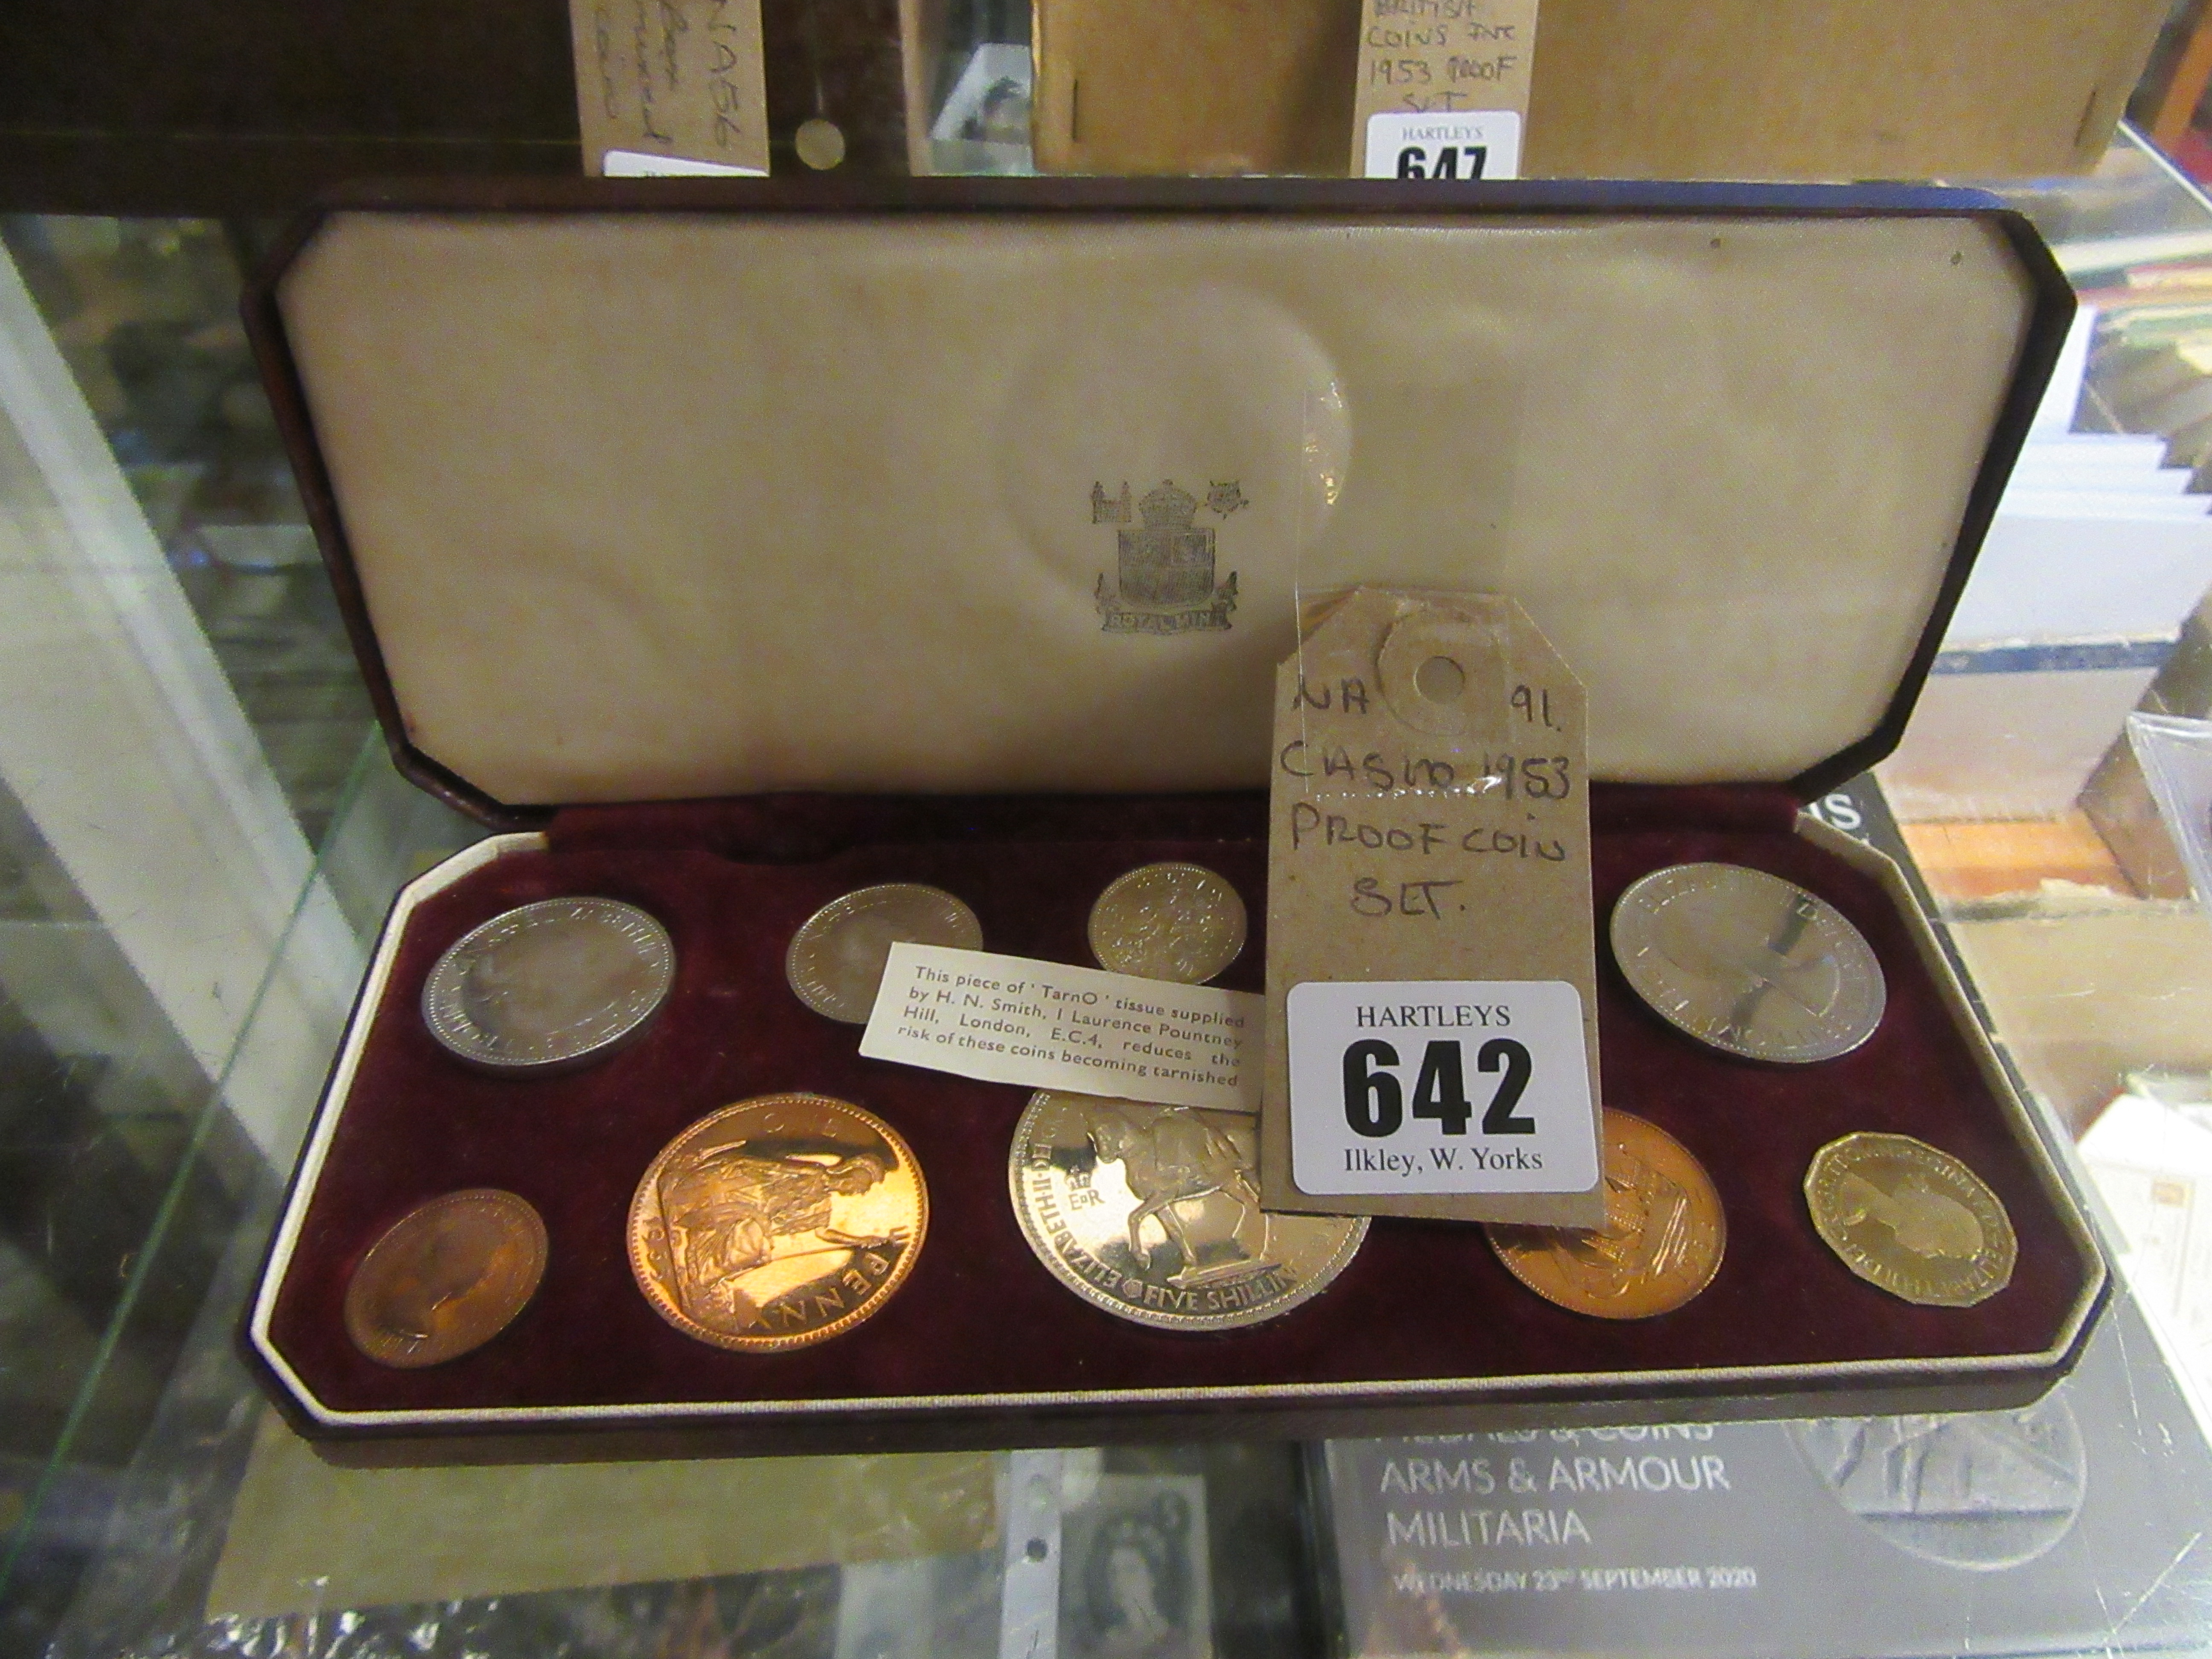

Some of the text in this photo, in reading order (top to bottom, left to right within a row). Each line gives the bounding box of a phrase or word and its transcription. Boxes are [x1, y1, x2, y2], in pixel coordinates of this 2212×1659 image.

[1371, 59, 1432, 84] 1953
[1402, 126, 1484, 141] HARTLEYS
[1396, 146, 1488, 179] 647
[1483, 750, 1571, 800] 1953
[1292, 802, 1448, 854] PROOF
[915, 965, 949, 983] This
[956, 974, 1001, 991] piece
[1007, 981, 1026, 994] of
[1116, 998, 1165, 1016] tissue
[1170, 1008, 1245, 1028] supplied
[1357, 1005, 1511, 1027] HARTLEYS
[903, 1005, 1240, 1066] Hill, London, E.C.4, reduces the
[908, 986, 929, 1002] by
[936, 989, 955, 1004] H.
[963, 993, 984, 1009] N.
[991, 998, 1047, 1020] Smith,
[1071, 1010, 1152, 1033] Laurence
[1158, 1023, 1242, 1050] Pountney
[897, 1025, 1238, 1087] risk of these coins becoming tarnished
[1342, 1037, 1536, 1138] 642
[1345, 1147, 1543, 1178] Ilkley, W. Yorks
[1143, 1284, 1199, 1310] FIVE
[1380, 1455, 1732, 1494] ARMS & ARMOUR
[1386, 1508, 1593, 1548] MILITARIA
[1580, 1566, 1705, 1592] SEPTEMBER
[1706, 1565, 1757, 1589] 2020
